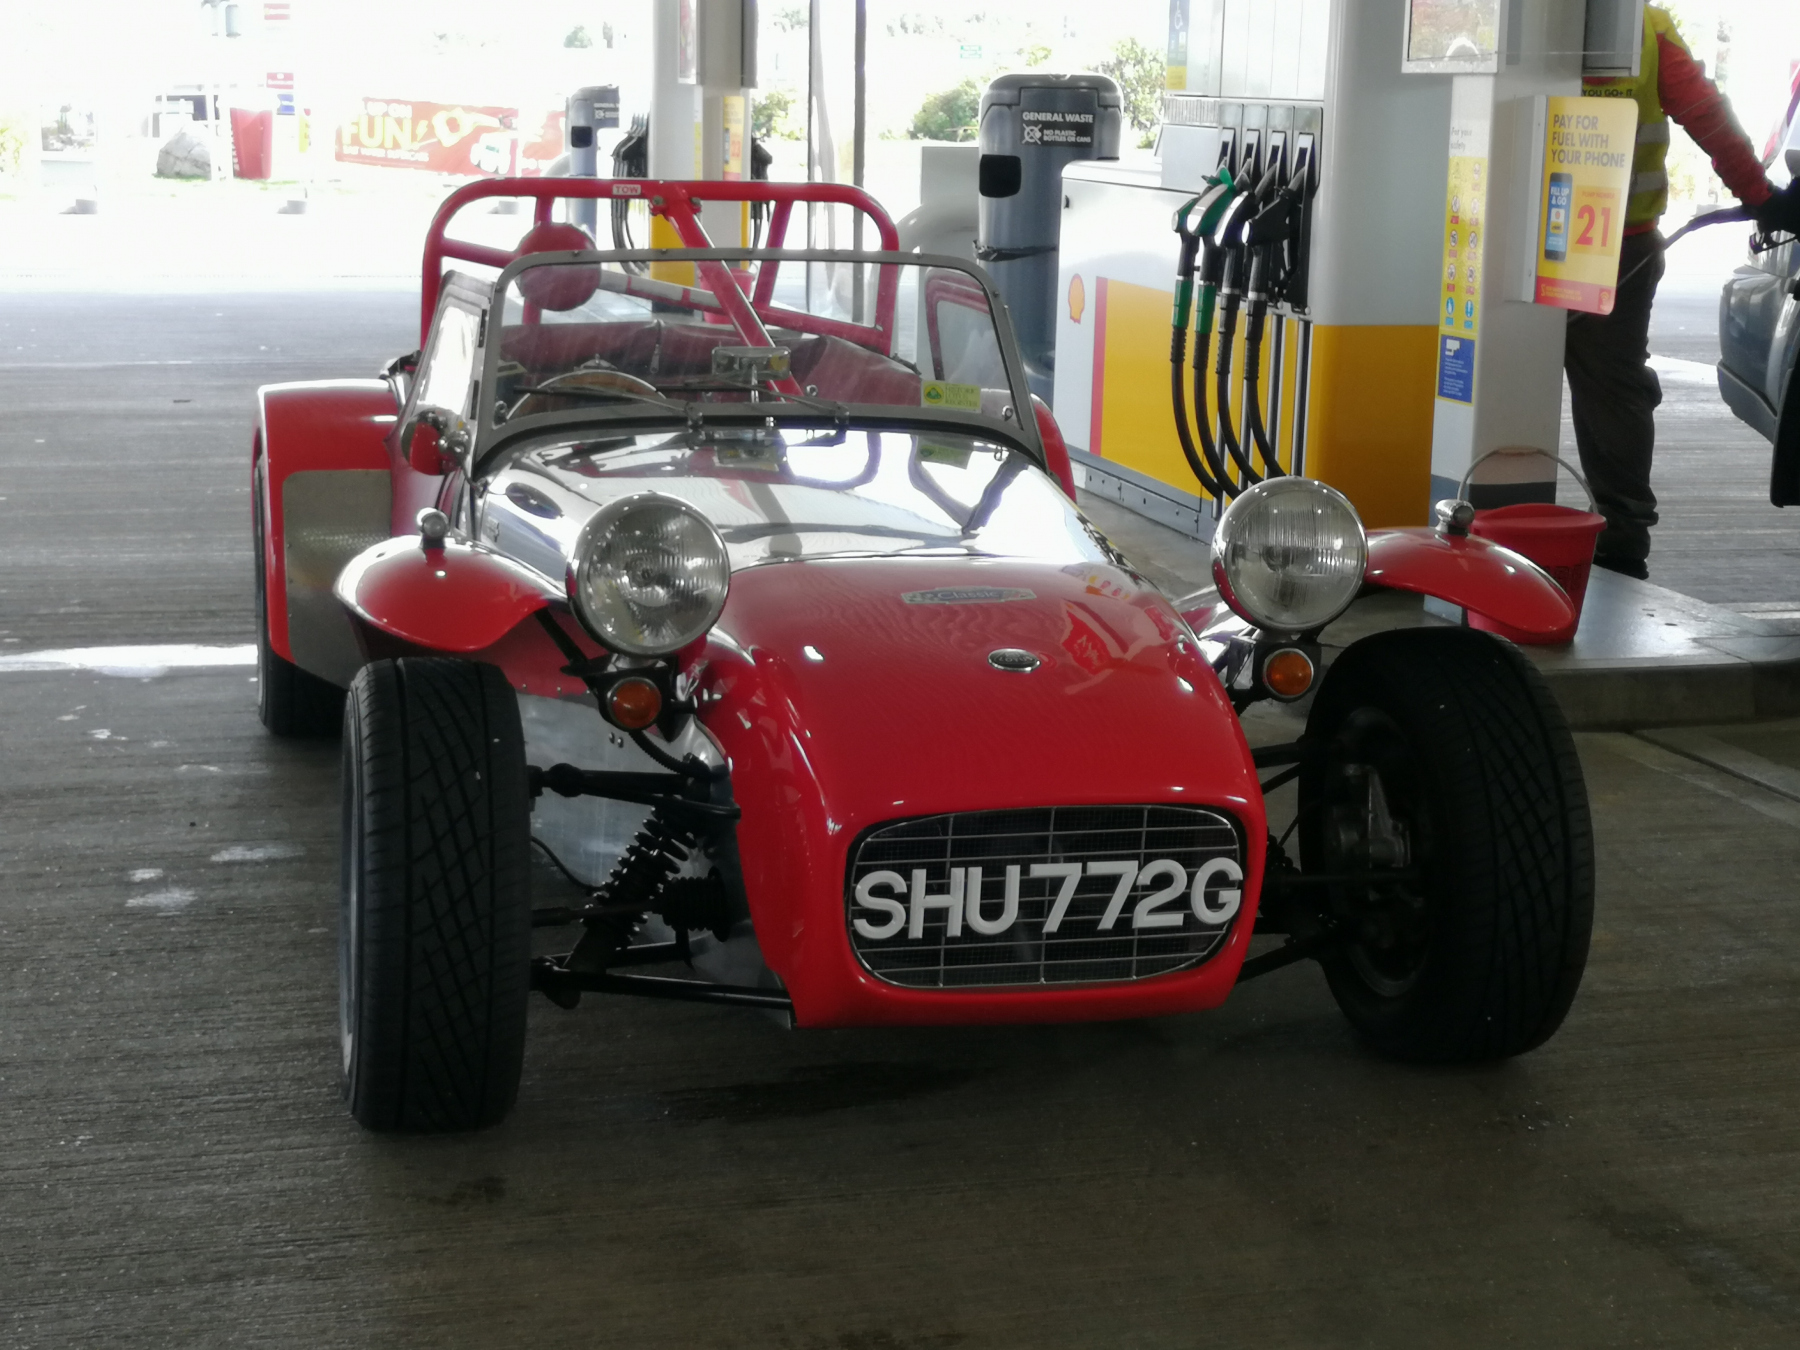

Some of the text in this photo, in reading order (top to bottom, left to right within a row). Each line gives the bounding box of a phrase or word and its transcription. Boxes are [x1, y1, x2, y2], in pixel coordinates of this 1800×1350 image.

[1626, 89, 1633, 97] IT
[1022, 111, 1094, 123] GENERAL WASTE
[1552, 114, 1599, 130] PAY FOR
[342, 114, 412, 150] FUN
[1551, 131, 1609, 149] FUEL WITH
[1551, 148, 1626, 168] YOUR PHONE
[615, 185, 639, 194] TOW
[1550, 186, 1570, 197] FILL UP
[1557, 196, 1567, 206] GO
[1575, 204, 1611, 248] 21
[938, 590, 1000, 600] Classic
[853, 857, 1243, 939] SHU772G
